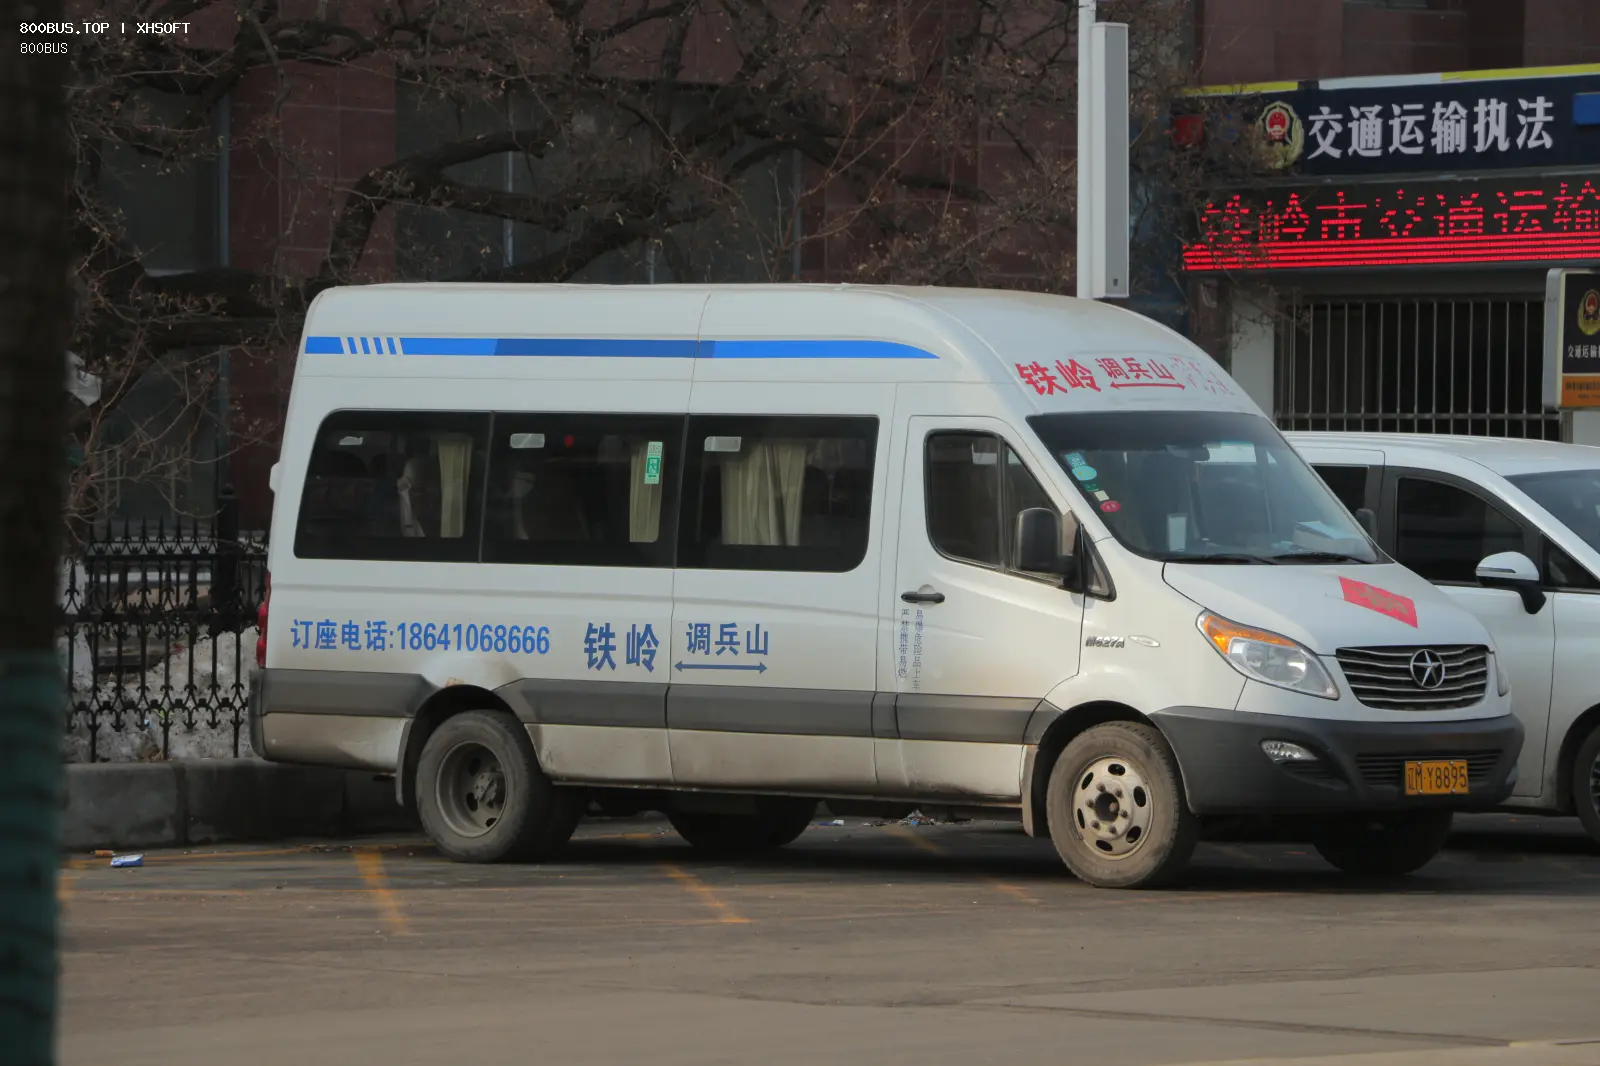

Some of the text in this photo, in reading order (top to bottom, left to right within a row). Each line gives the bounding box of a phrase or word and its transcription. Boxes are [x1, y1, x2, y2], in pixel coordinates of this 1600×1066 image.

[1307, 96, 1554, 159] 交通运输执法
[1567, 344, 1600, 359] 交通运输
[1015, 358, 1101, 396] 铁岭
[1095, 357, 1176, 380] 调兵山
[290, 618, 550, 655] 订座电话:18641068666
[583, 622, 769, 674] 铁岭 调兵山
